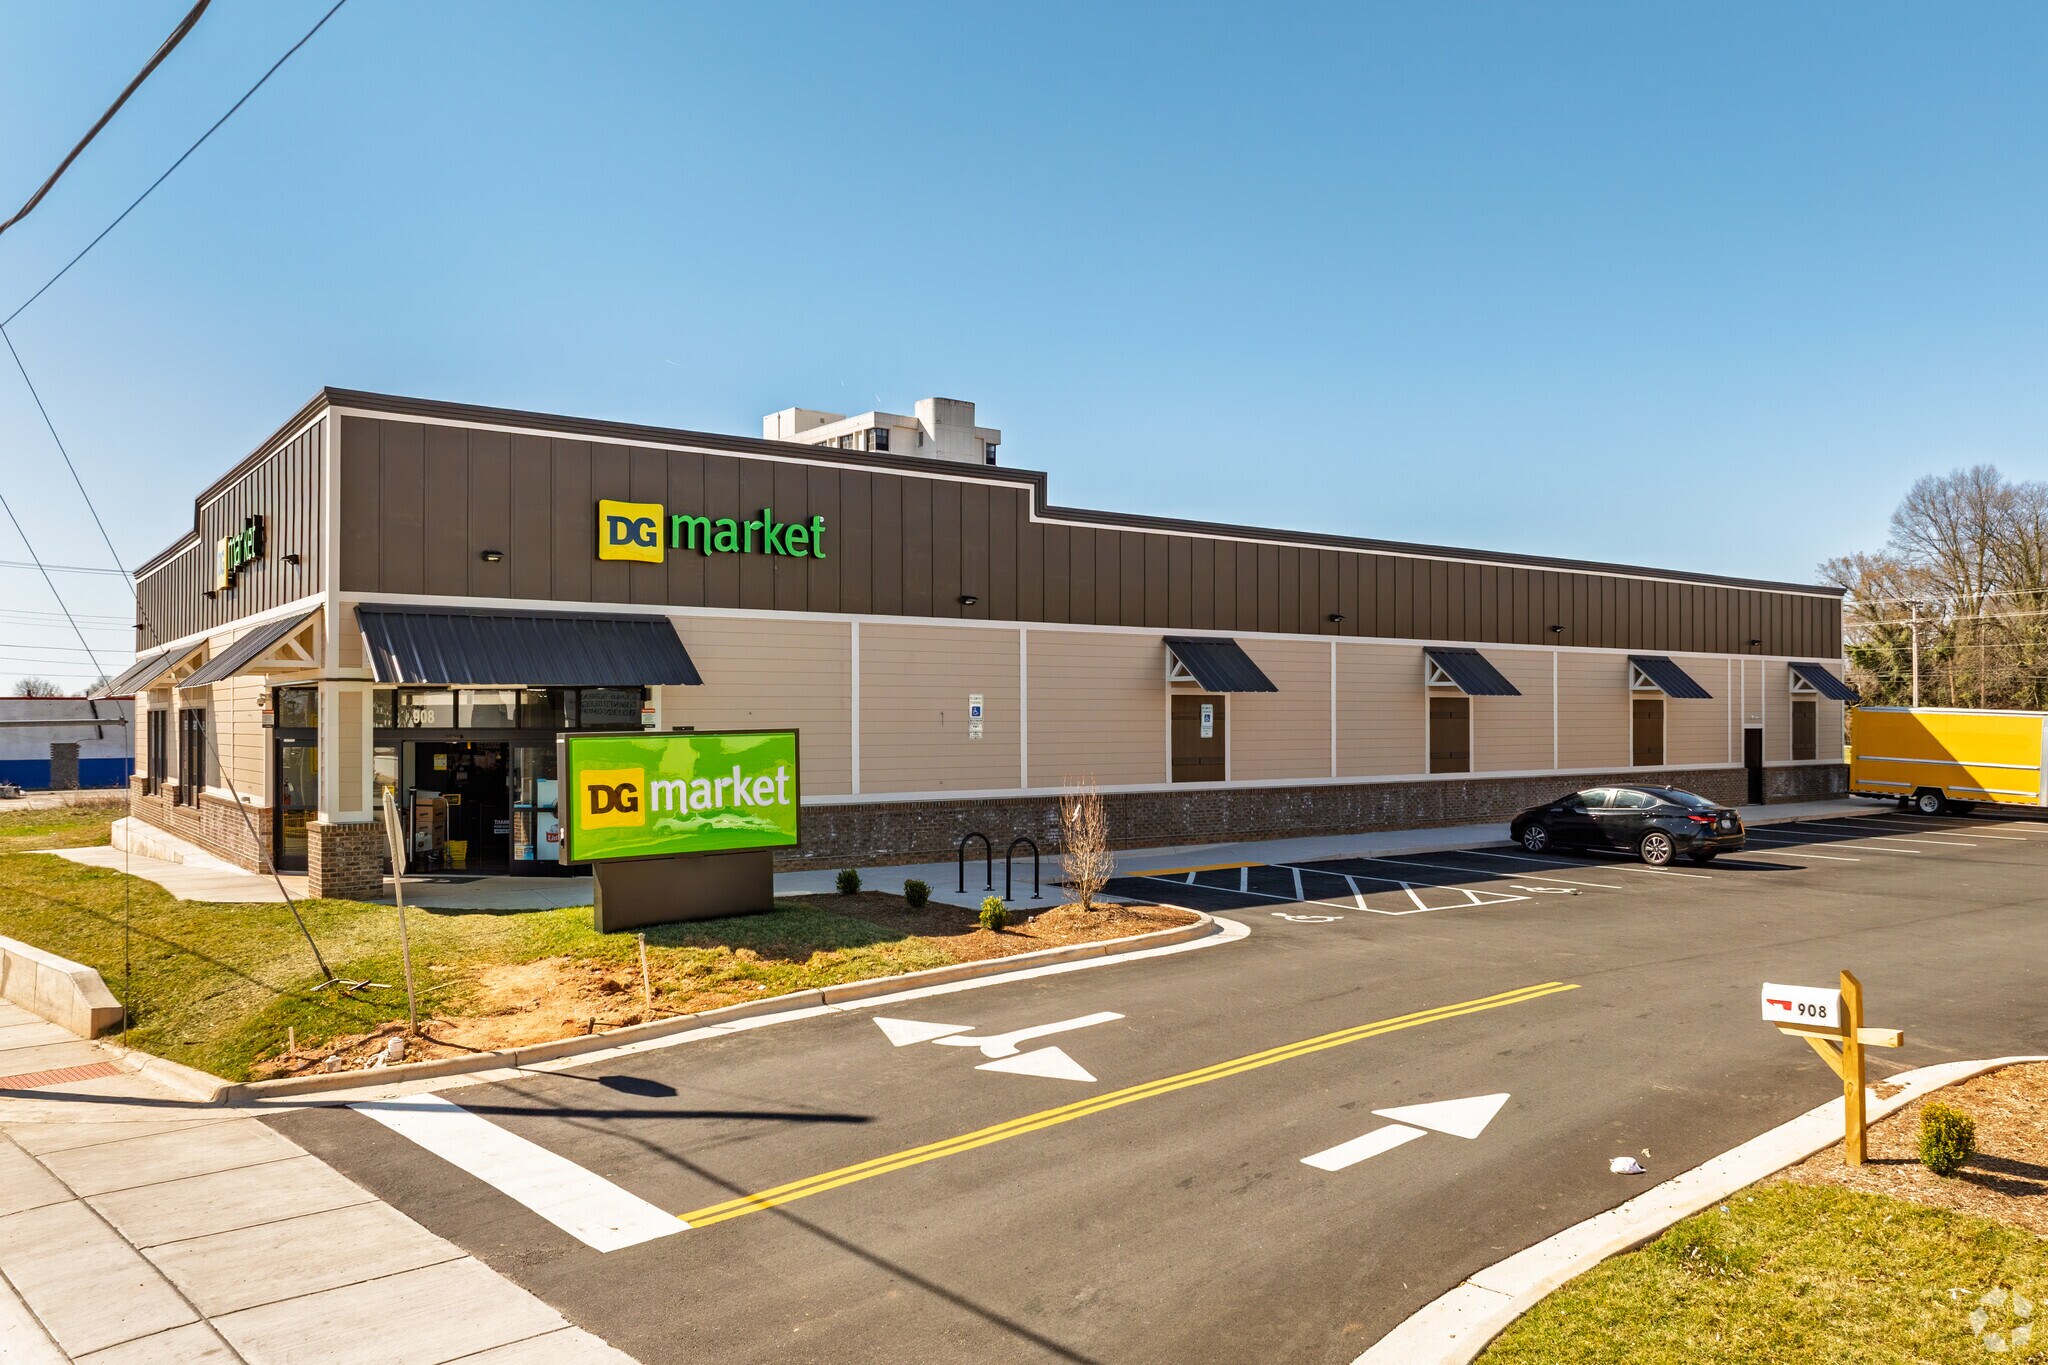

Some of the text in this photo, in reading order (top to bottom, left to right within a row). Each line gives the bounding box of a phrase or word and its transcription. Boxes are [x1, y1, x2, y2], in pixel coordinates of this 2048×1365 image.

[228, 515, 260, 572] market
[606, 507, 827, 559] DG market
[412, 709, 435, 724] 908
[587, 764, 790, 815] DG market
[1797, 1003, 1827, 1018] 908
